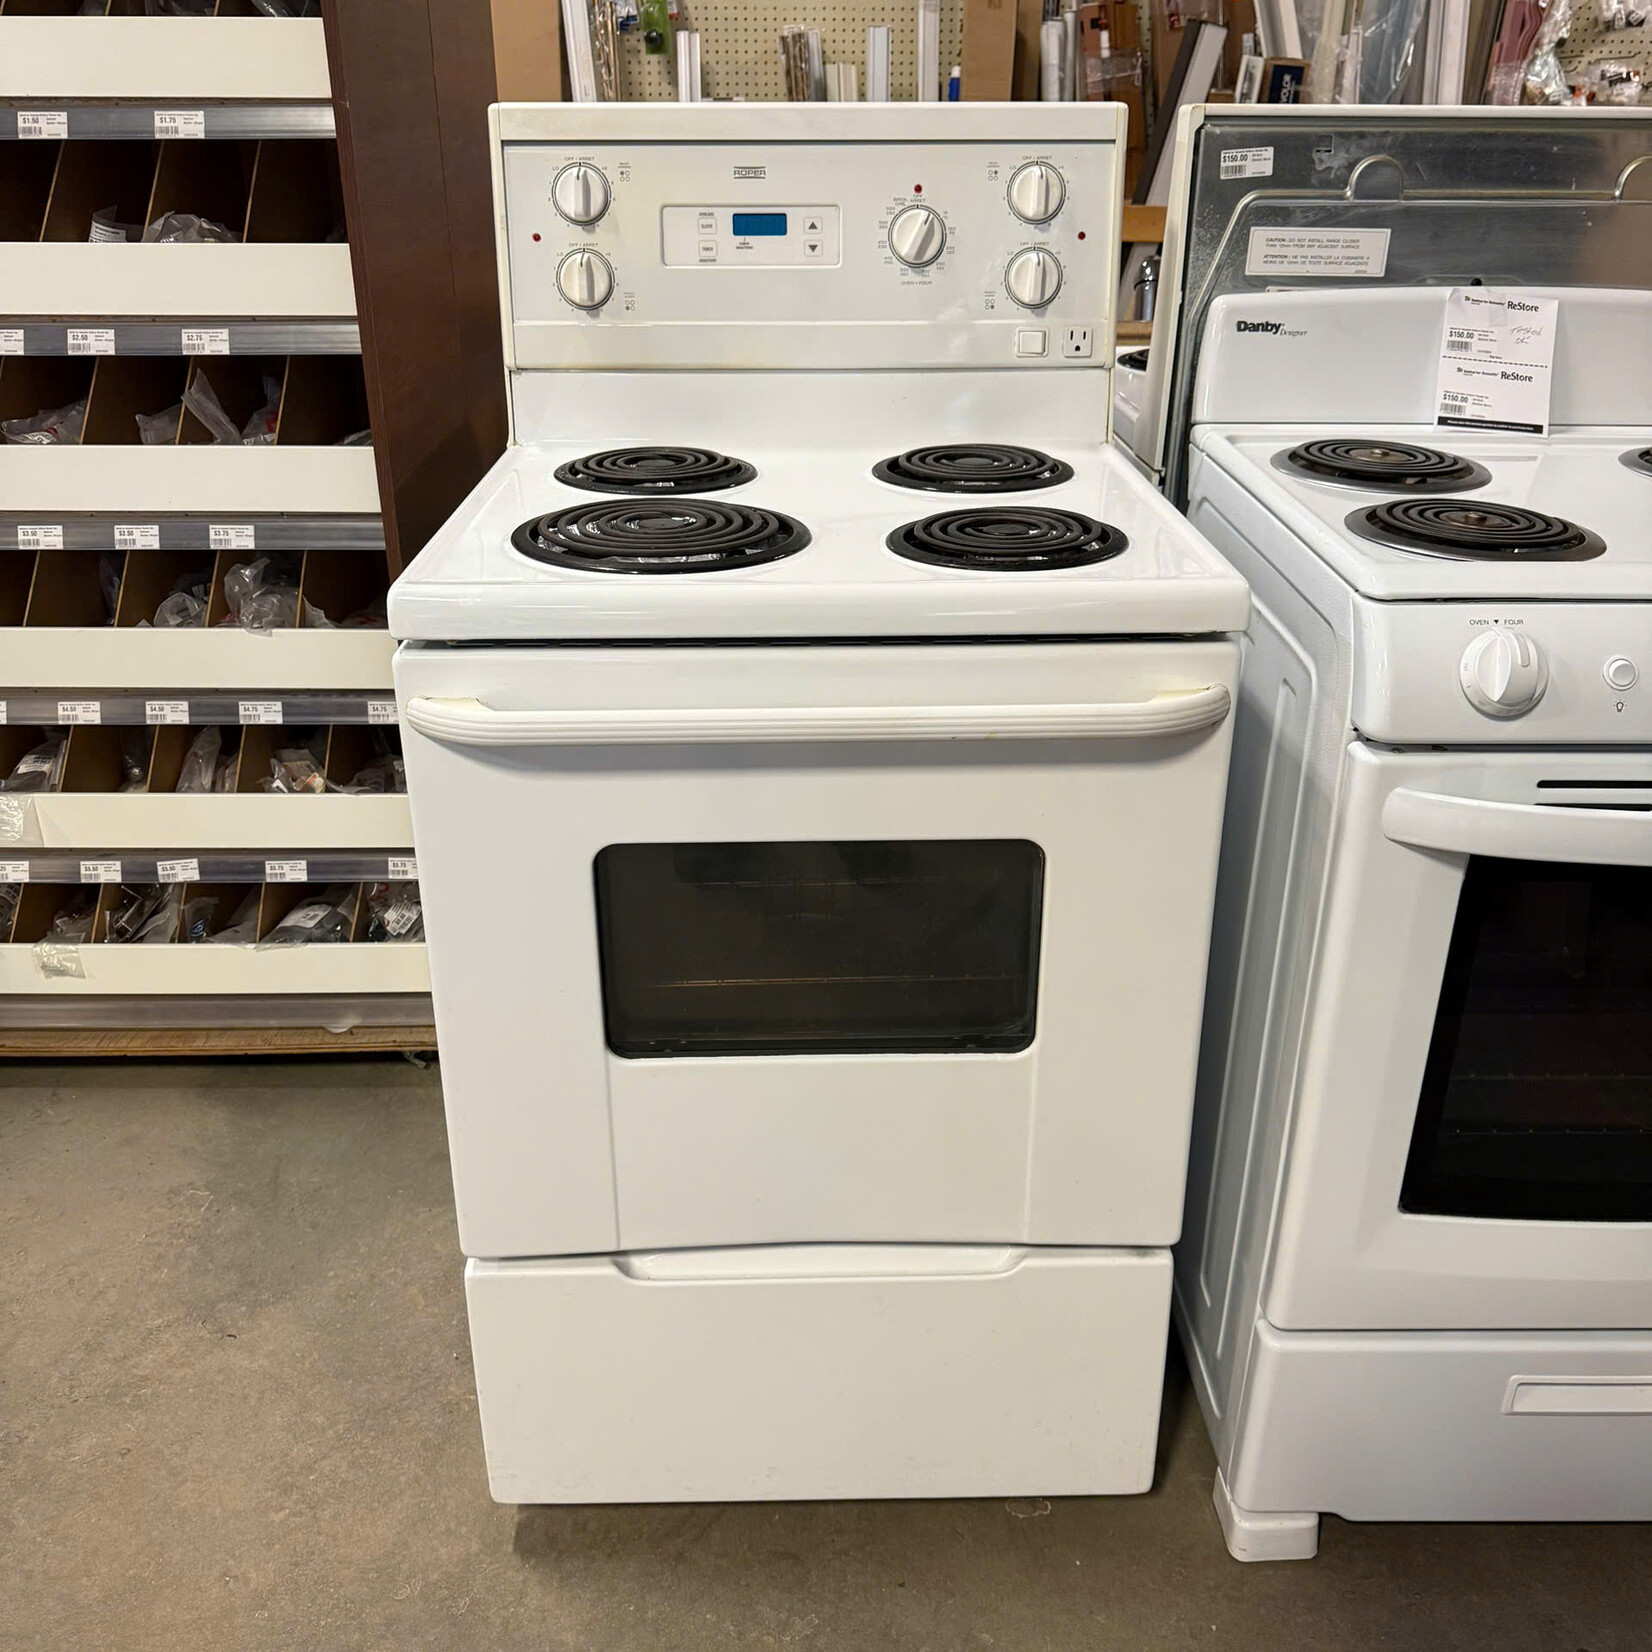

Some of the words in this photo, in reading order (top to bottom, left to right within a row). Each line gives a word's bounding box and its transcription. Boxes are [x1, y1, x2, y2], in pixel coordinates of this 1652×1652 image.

[1222, 154, 1248, 163] $150.00
[733, 168, 766, 177] ROPER
[1507, 301, 1539, 312] ReStore
[1236, 320, 1281, 335] Danby
[1449, 331, 1474, 339] $150.00
[1500, 371, 1533, 382] ReStore
[1443, 394, 1468, 403] $150.00
